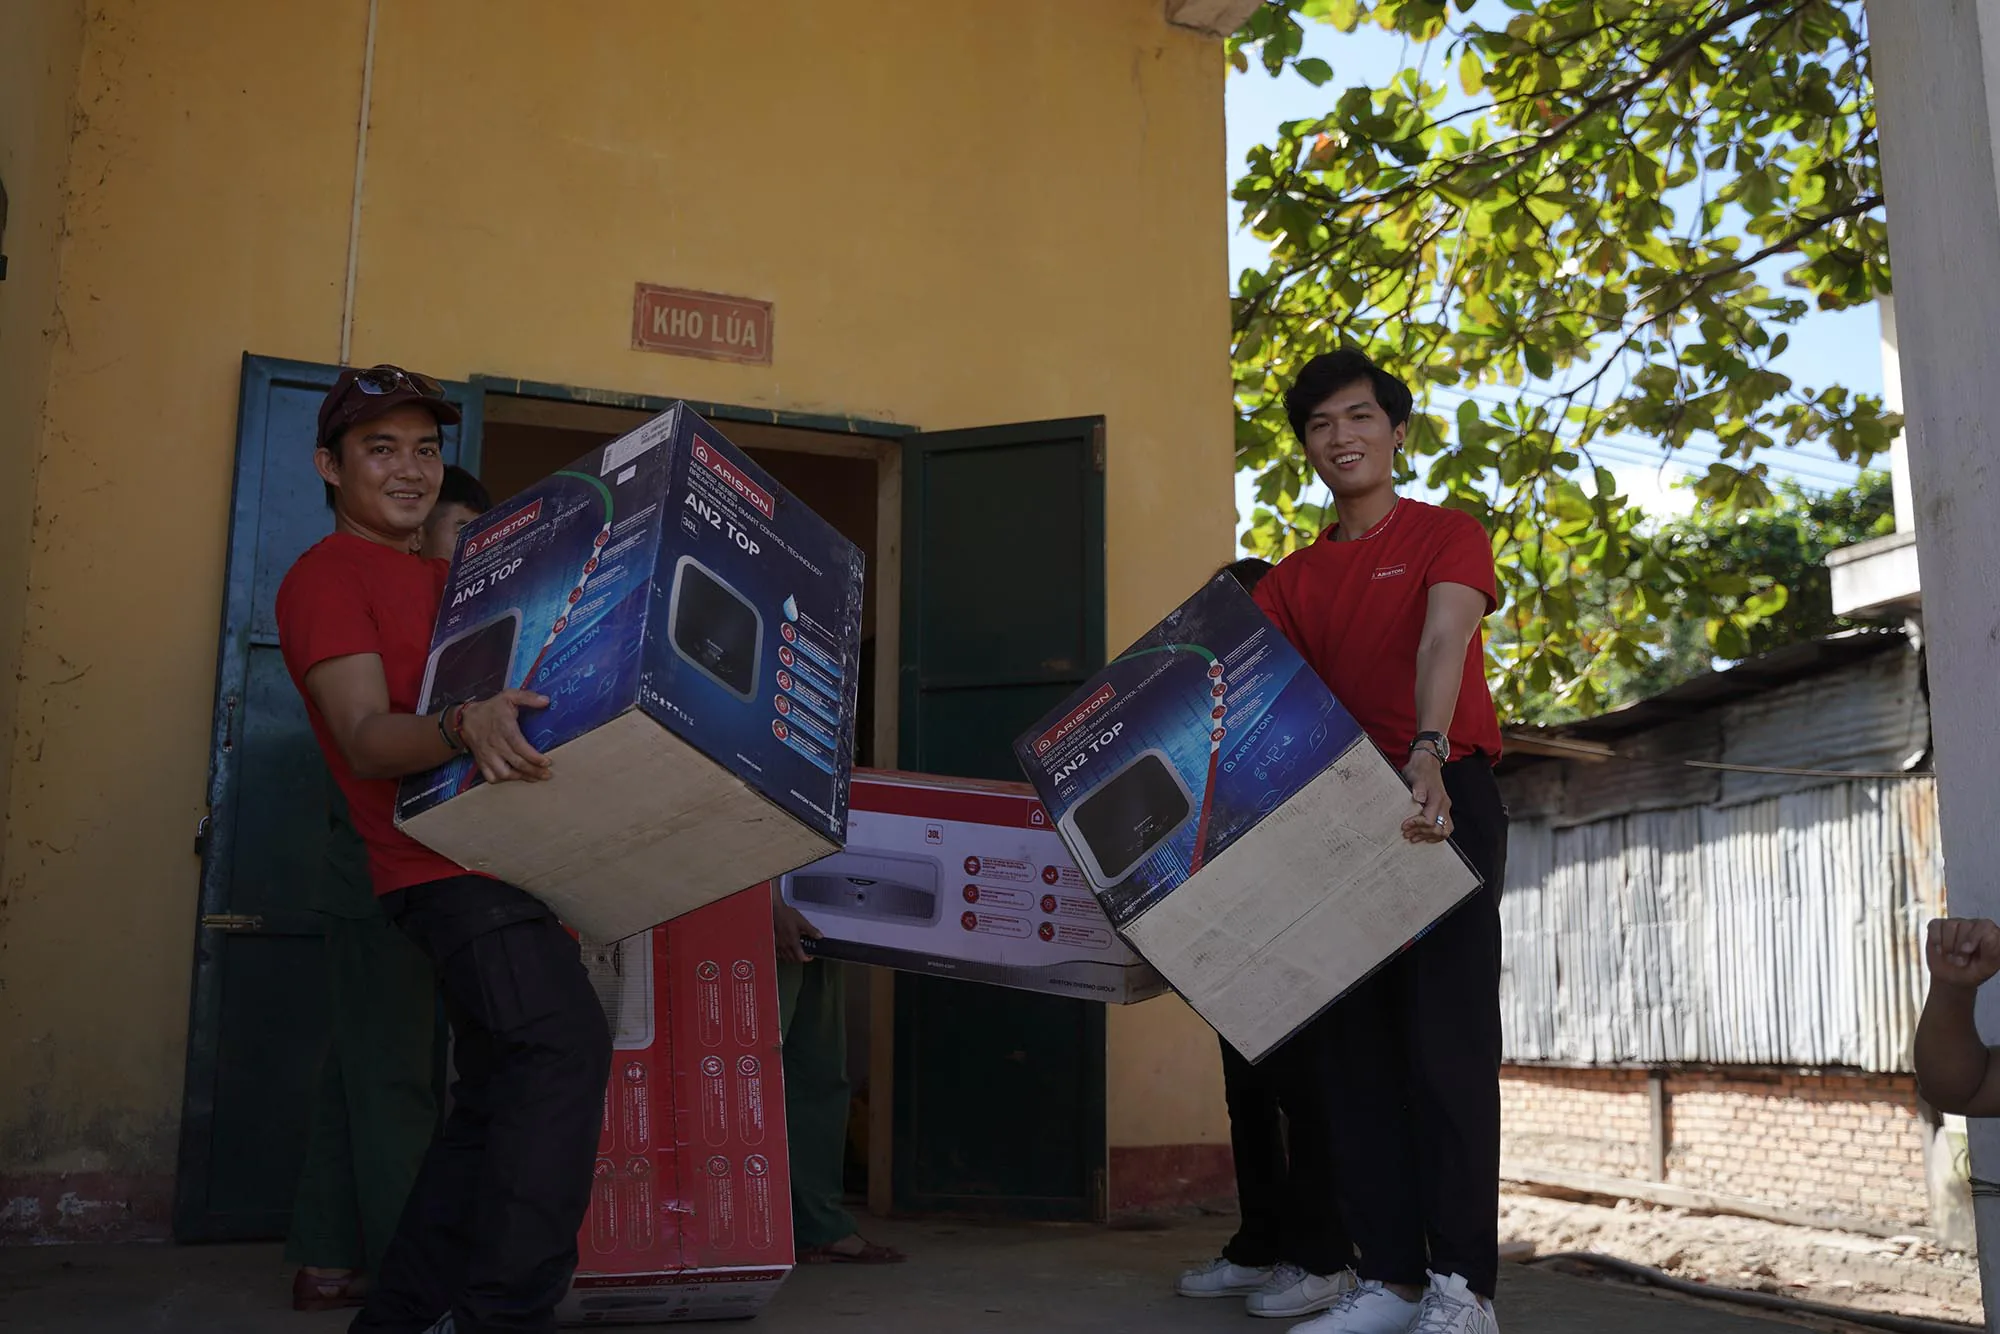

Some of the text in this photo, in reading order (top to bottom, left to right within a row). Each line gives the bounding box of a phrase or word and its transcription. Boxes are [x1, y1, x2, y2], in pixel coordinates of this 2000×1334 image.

[652, 306, 757, 348] KHO LÚA
[713, 464, 769, 512] ARISTON
[481, 510, 537, 548] ARISTON
[682, 516, 698, 535] 30L
[684, 492, 721, 530] AN2
[726, 521, 760, 556] TOP
[688, 467, 738, 510] BREAKTHROUGH
[738, 506, 760, 527] SMART
[760, 523, 787, 549] CONTROL
[787, 545, 823, 577] TECHNOLOGY
[451, 578, 486, 608] AN2
[490, 557, 523, 586] TOP
[1377, 568, 1404, 577] ARISTON
[551, 625, 600, 672] ARISTON
[1043, 727, 1090, 767] BREAKTHROUGH
[1089, 711, 1110, 730] SMART
[1110, 689, 1138, 713] CONTROL
[1137, 657, 1175, 690] TECHNOLOGY
[1056, 692, 1110, 740] ARISTON
[1054, 752, 1089, 787] AN2
[1088, 721, 1124, 753] TOP
[1235, 714, 1275, 762] ARISTON
[1061, 784, 1077, 798] 30L
[927, 829, 941, 840] 30L
[1049, 978, 1116, 993] ARISTON THERMO GROUP
[687, 1275, 774, 1283] ARISTON
